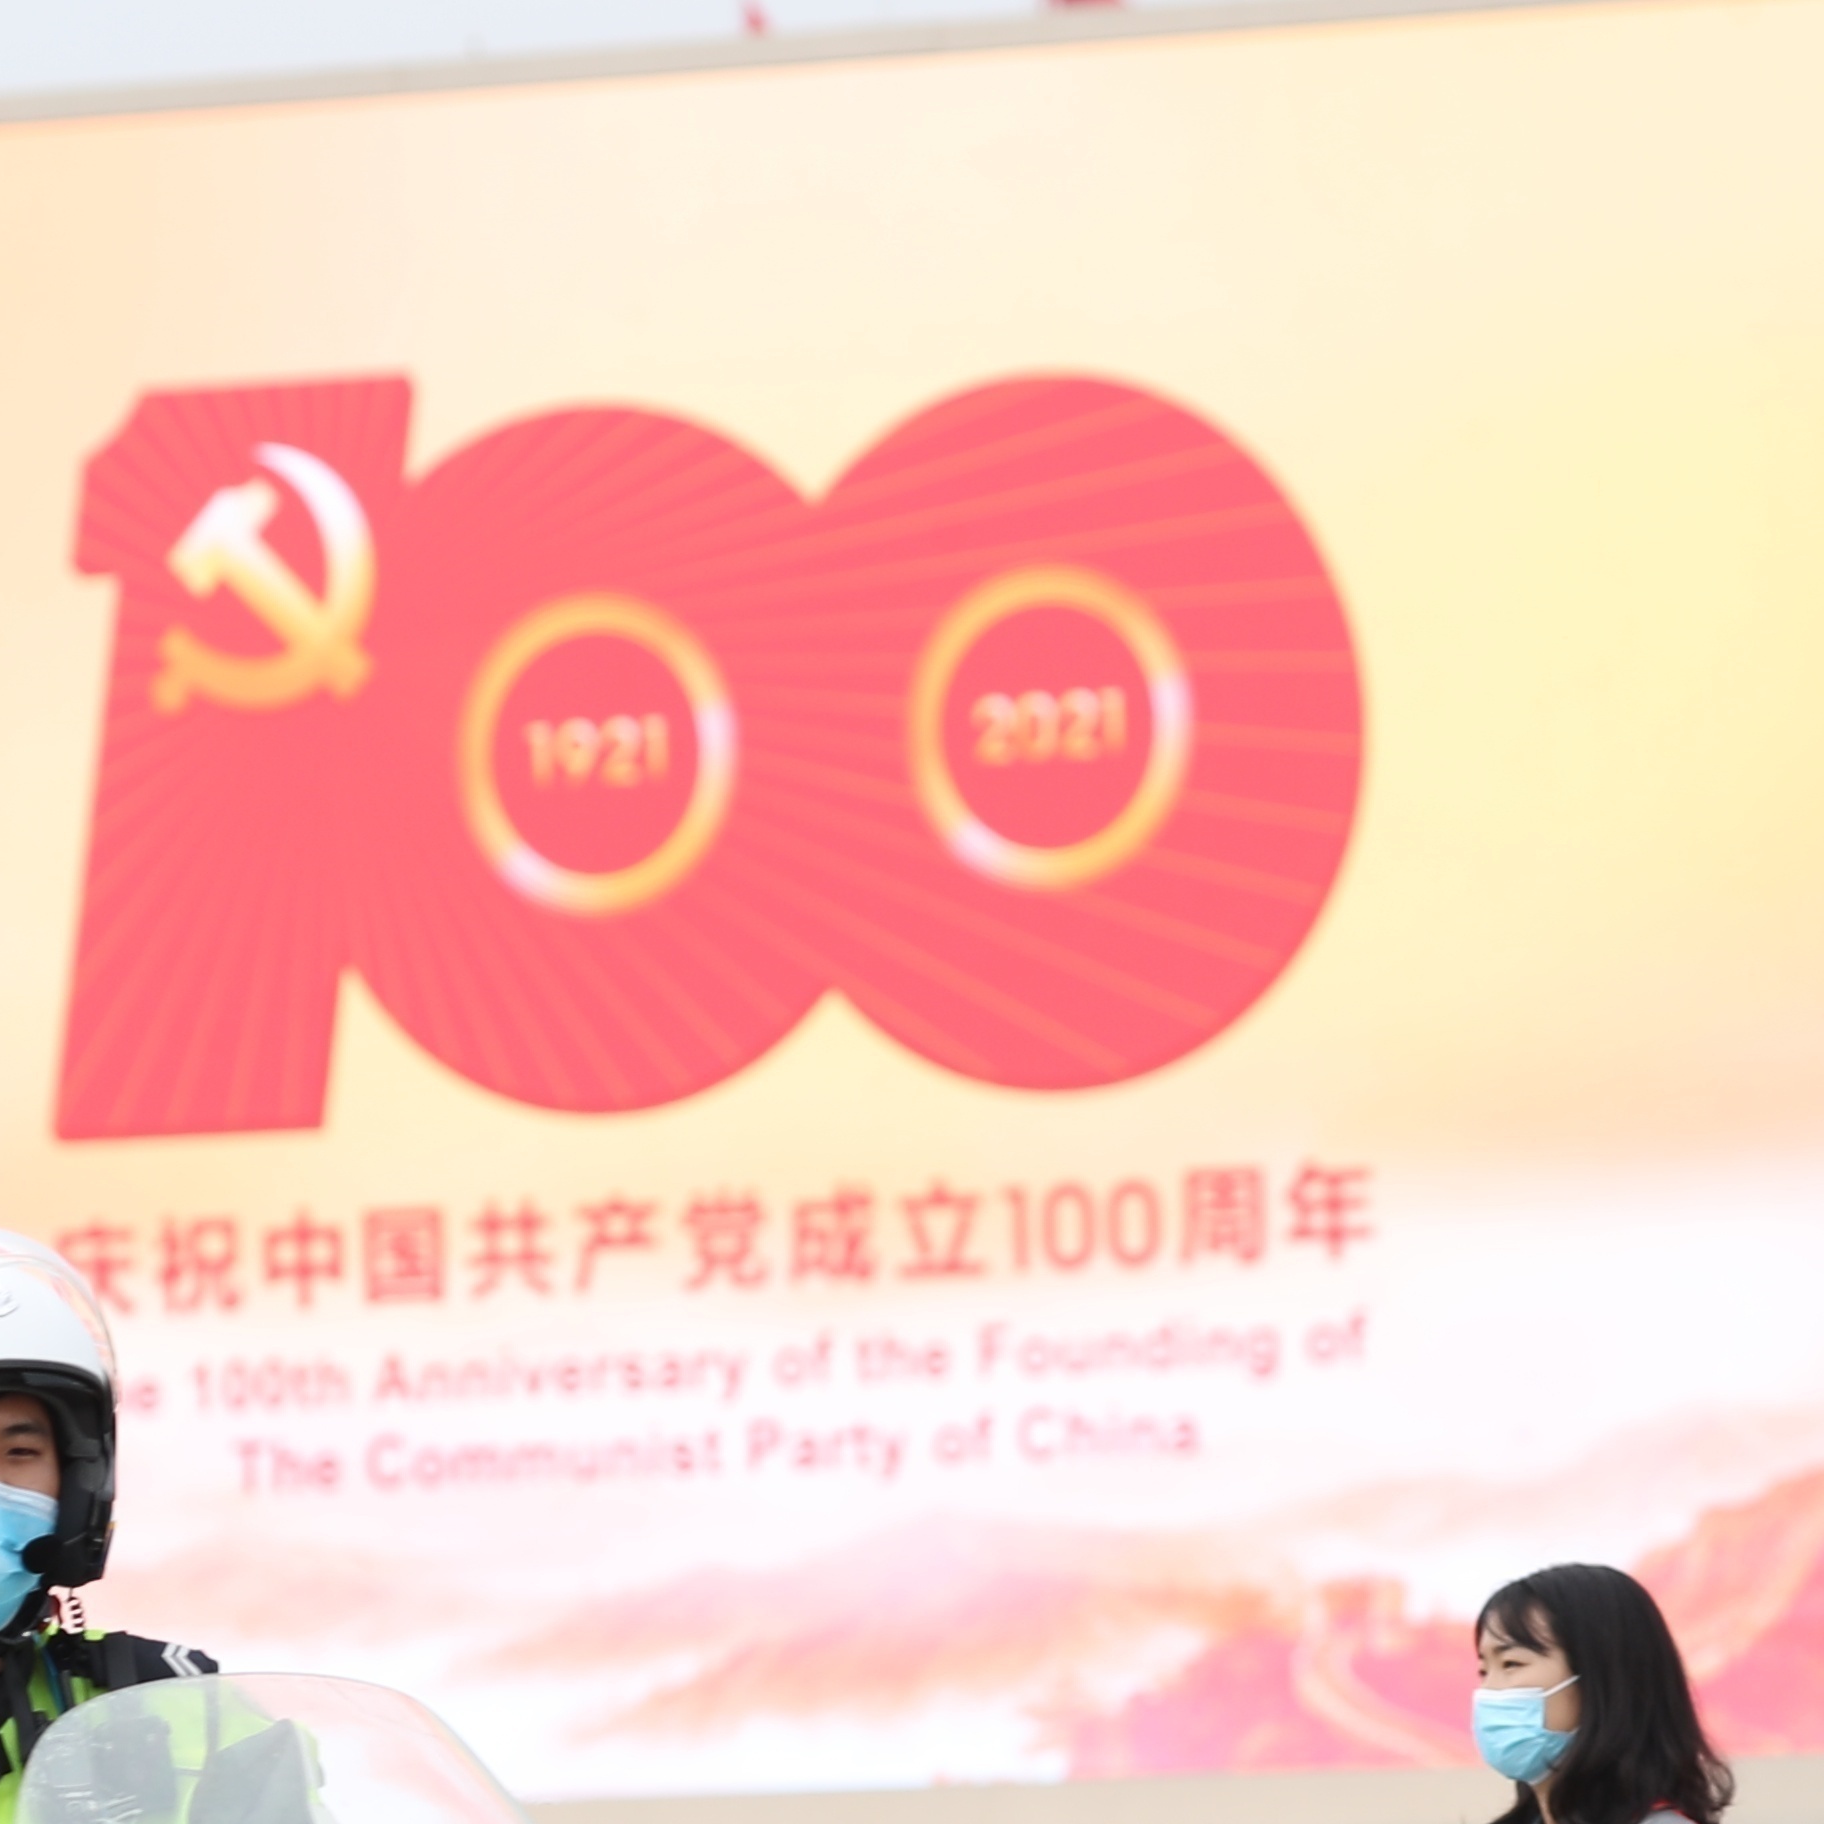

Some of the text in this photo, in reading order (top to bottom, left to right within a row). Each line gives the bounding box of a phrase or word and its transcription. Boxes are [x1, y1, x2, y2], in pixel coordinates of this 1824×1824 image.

[522, 711, 670, 790] 1921
[970, 685, 1128, 766] 2021
[54, 1158, 1378, 1318] 庆祝中国共产党成立100周年
[192, 1352, 354, 1416] 100th
[373, 1345, 749, 1406] Anniversary
[773, 1326, 834, 1389] of
[854, 1333, 953, 1387] the
[976, 1312, 1282, 1385] Founding
[1301, 1303, 1369, 1369] of
[234, 1400, 1202, 1494] The Communist Party of China
